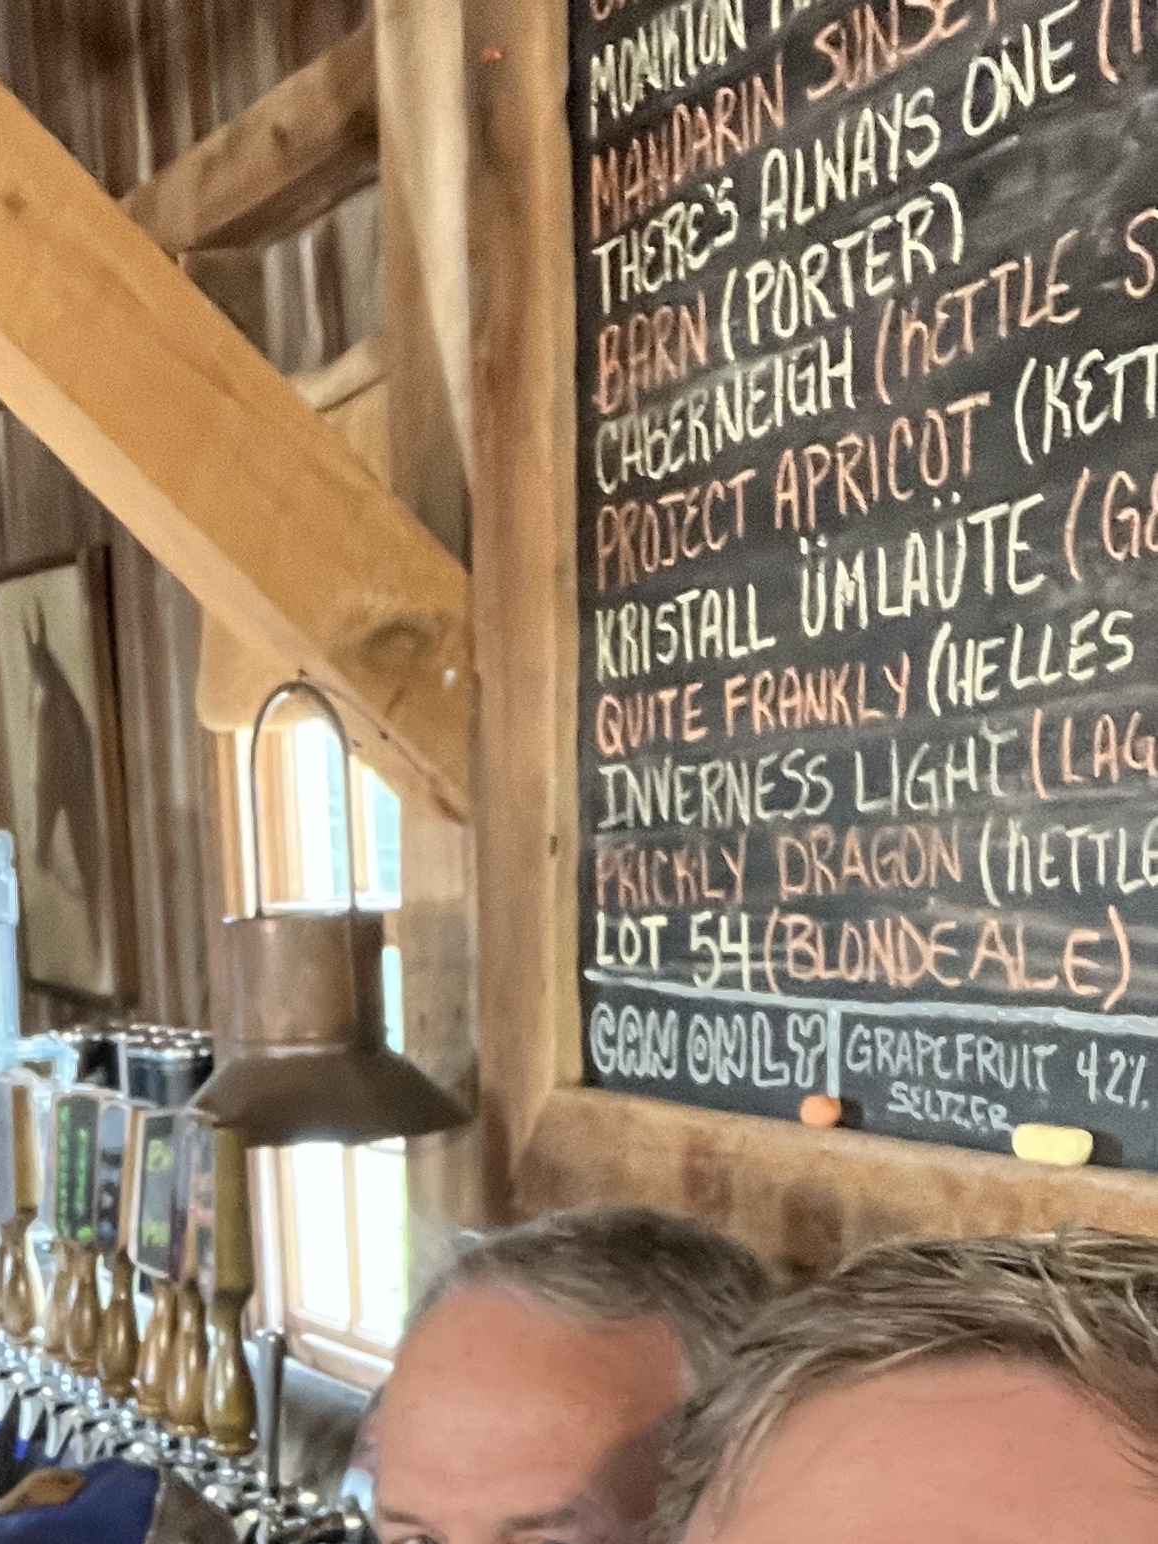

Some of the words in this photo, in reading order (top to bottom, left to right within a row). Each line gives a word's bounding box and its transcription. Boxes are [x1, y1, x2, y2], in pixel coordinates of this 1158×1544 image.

[590, 50, 787, 242] MANDARIN
[760, 86, 941, 240] ALWAYS
[592, 288, 708, 414] BARN
[720, 182, 964, 361] (PORTER)
[595, 325, 856, 496] CABERNEIGH
[596, 467, 758, 592] PROJECT
[773, 391, 992, 532] APRICOT
[594, 584, 777, 683] KRISTALL
[595, 682, 710, 756] QUITE
[722, 650, 912, 738] FRANKLY
[927, 609, 1136, 717] (HELLES
[597, 748, 835, 830] INVERNESS
[854, 718, 1018, 818] LIGHT
[776, 822, 963, 900] DRAGON
[596, 911, 669, 974] LOT
[690, 911, 752, 994] 54
[590, 1001, 679, 1082] CAN
[687, 1010, 827, 1088] ONLY
[888, 1080, 1014, 1135] SELTZER
